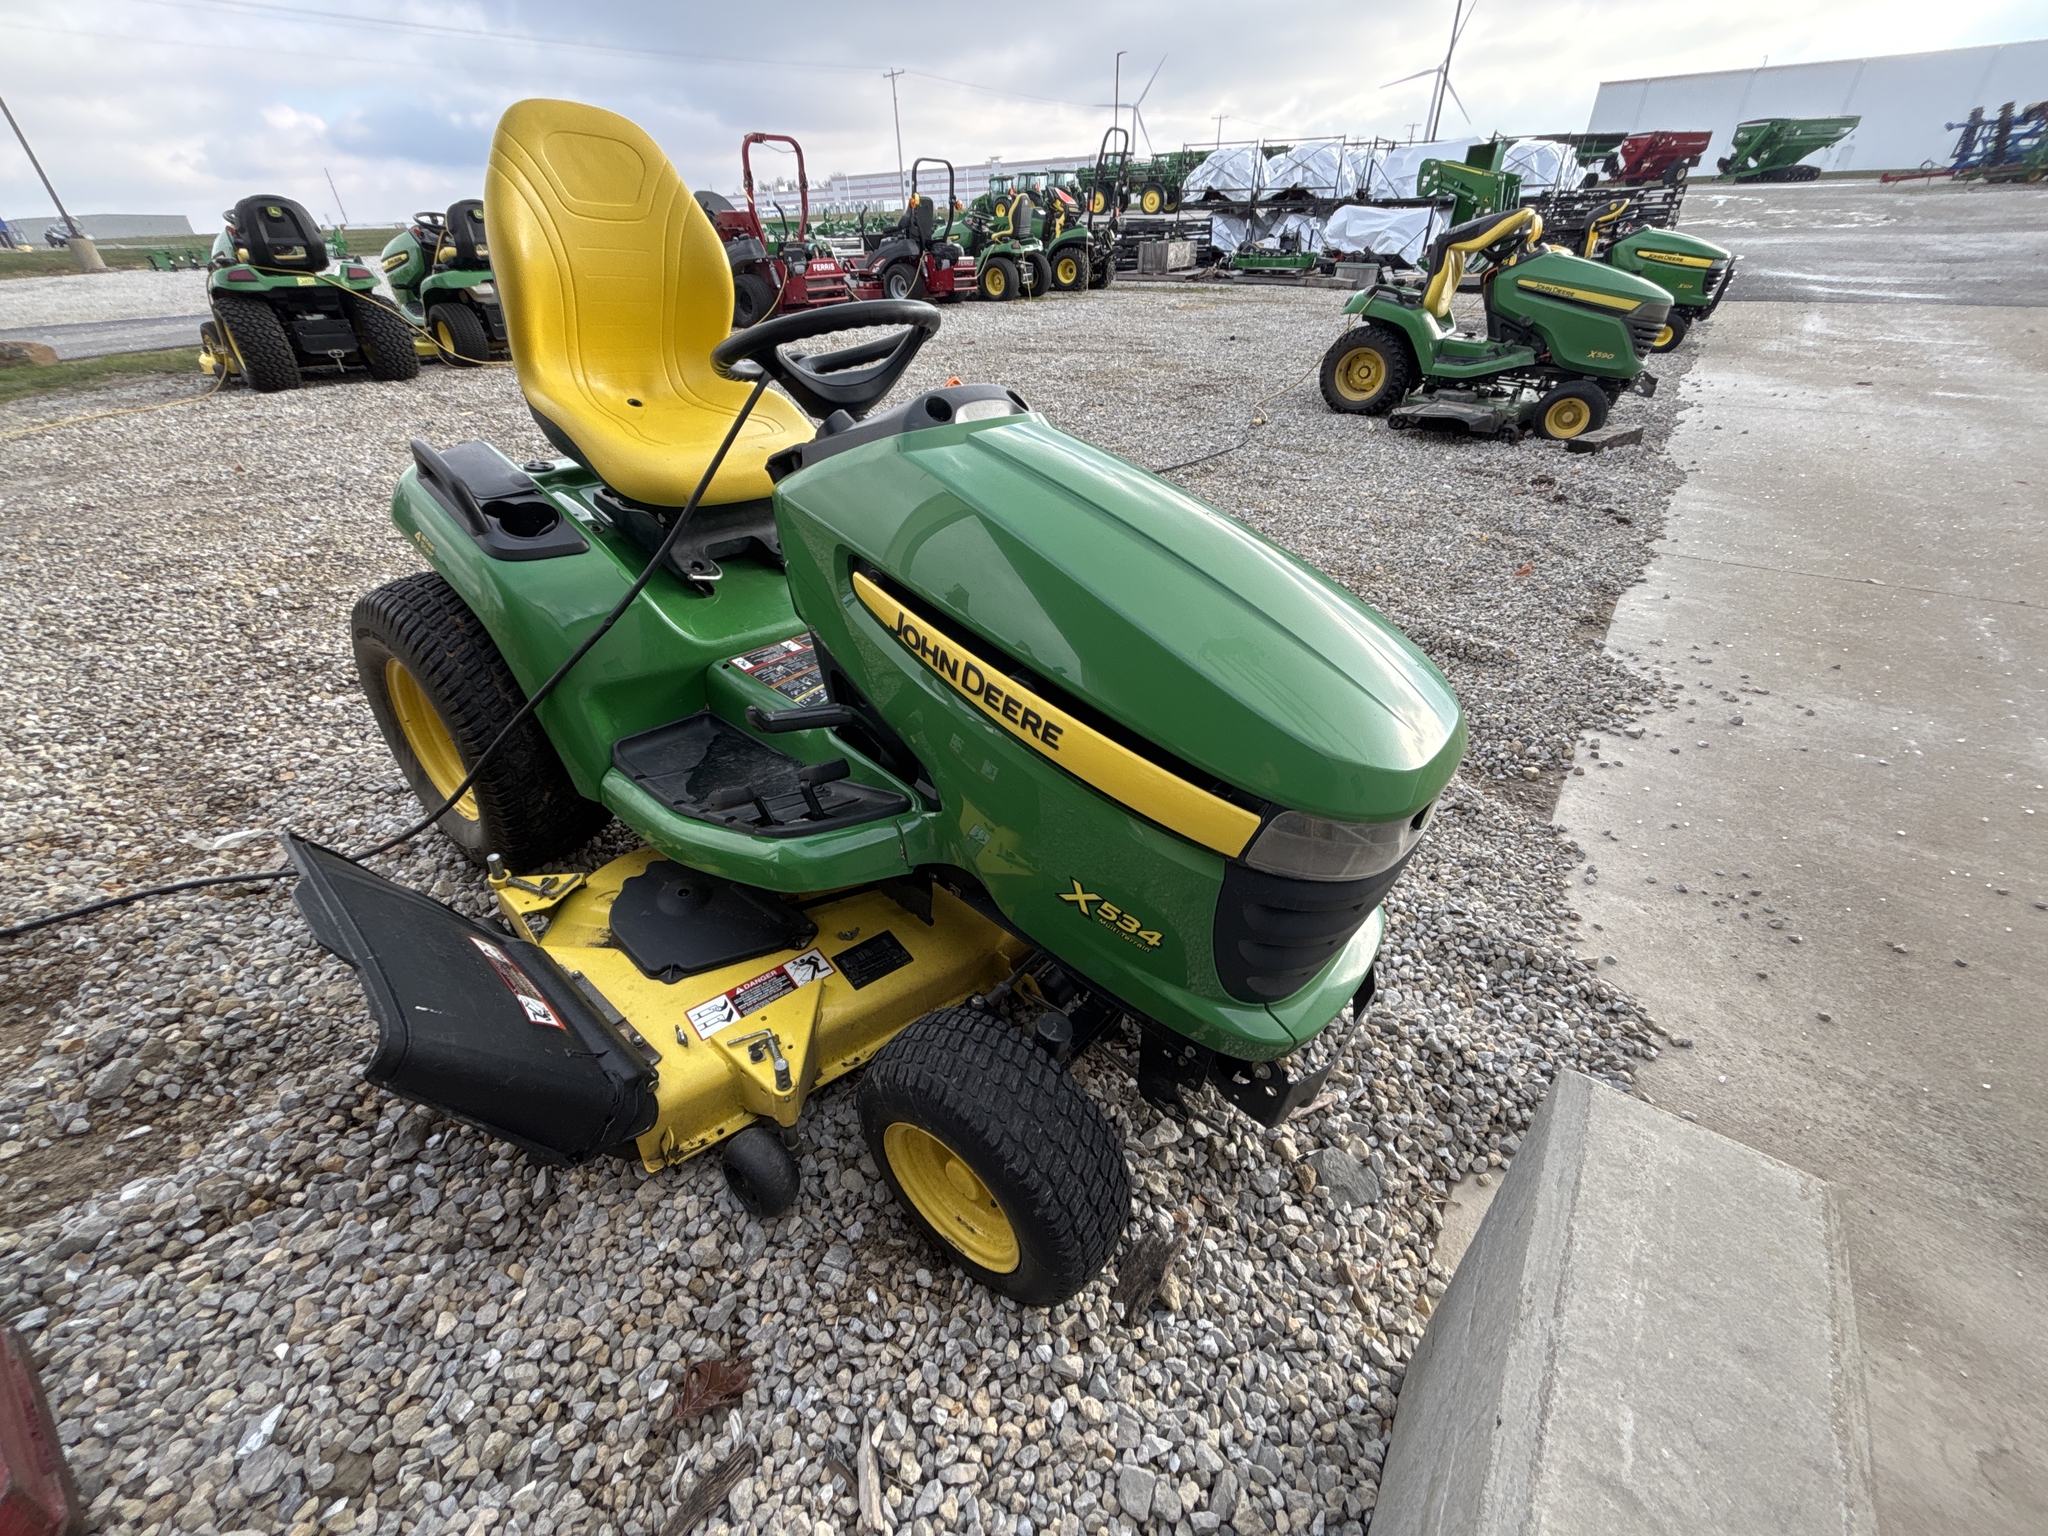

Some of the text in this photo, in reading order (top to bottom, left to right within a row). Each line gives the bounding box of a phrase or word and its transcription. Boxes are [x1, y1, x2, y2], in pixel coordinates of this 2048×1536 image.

[1664, 254, 1684, 262] DEERE
[812, 262, 835, 271] FERRIS
[1535, 282, 1575, 297] JOHN DEERE
[1587, 350, 1614, 359] X590
[889, 611, 959, 681] JOHN
[961, 660, 1064, 751] DEERE
[1056, 876, 1165, 947] X534
[743, 970, 778, 990] DANGER
